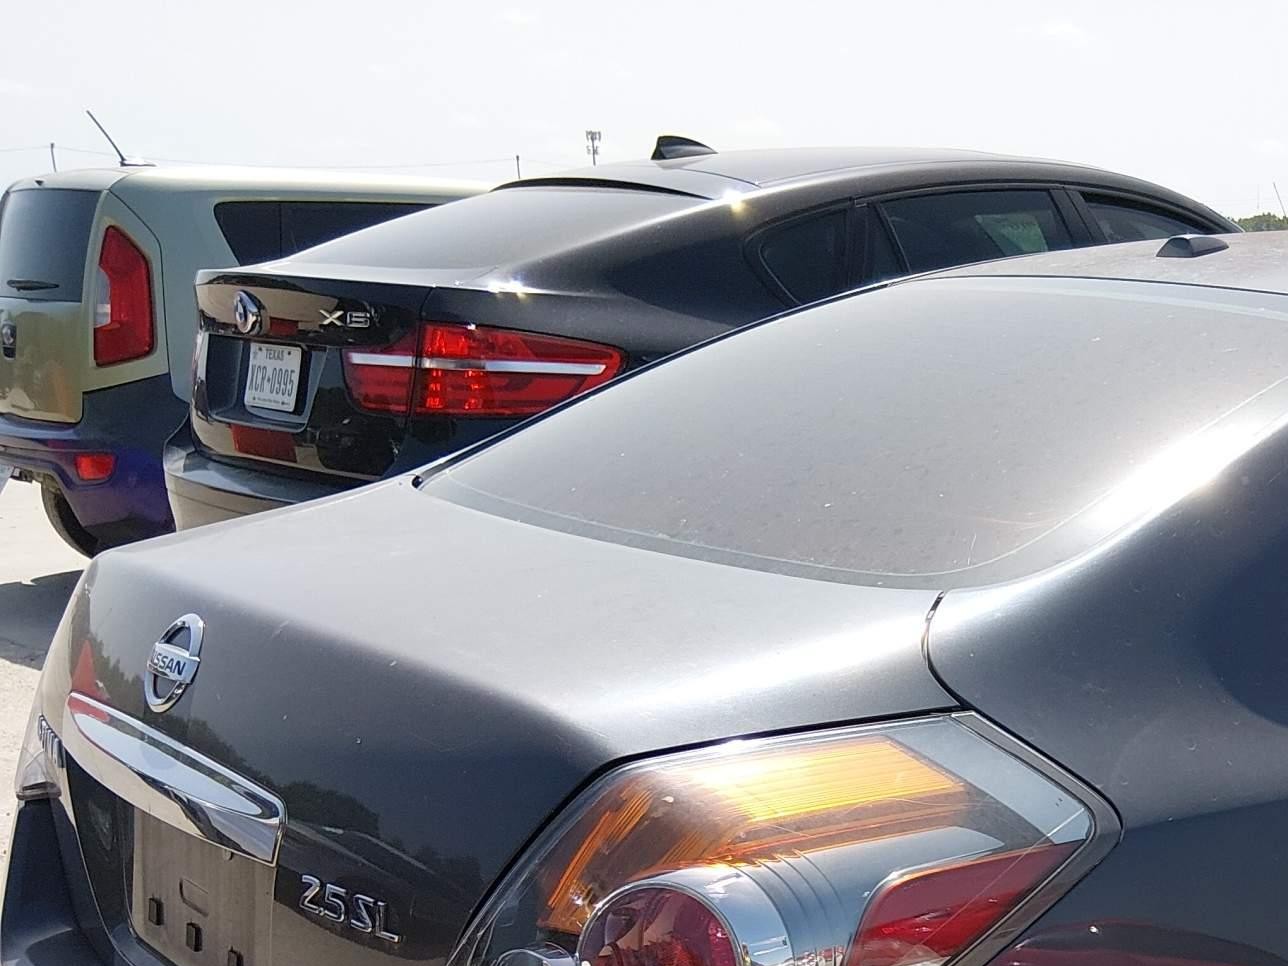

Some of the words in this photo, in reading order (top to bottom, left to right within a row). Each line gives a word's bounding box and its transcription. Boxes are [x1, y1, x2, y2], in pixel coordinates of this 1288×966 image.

[319, 309, 371, 328] X6
[265, 348, 285, 361] TEXAS
[299, 873, 346, 923] 2.5
[349, 893, 400, 943] SL
